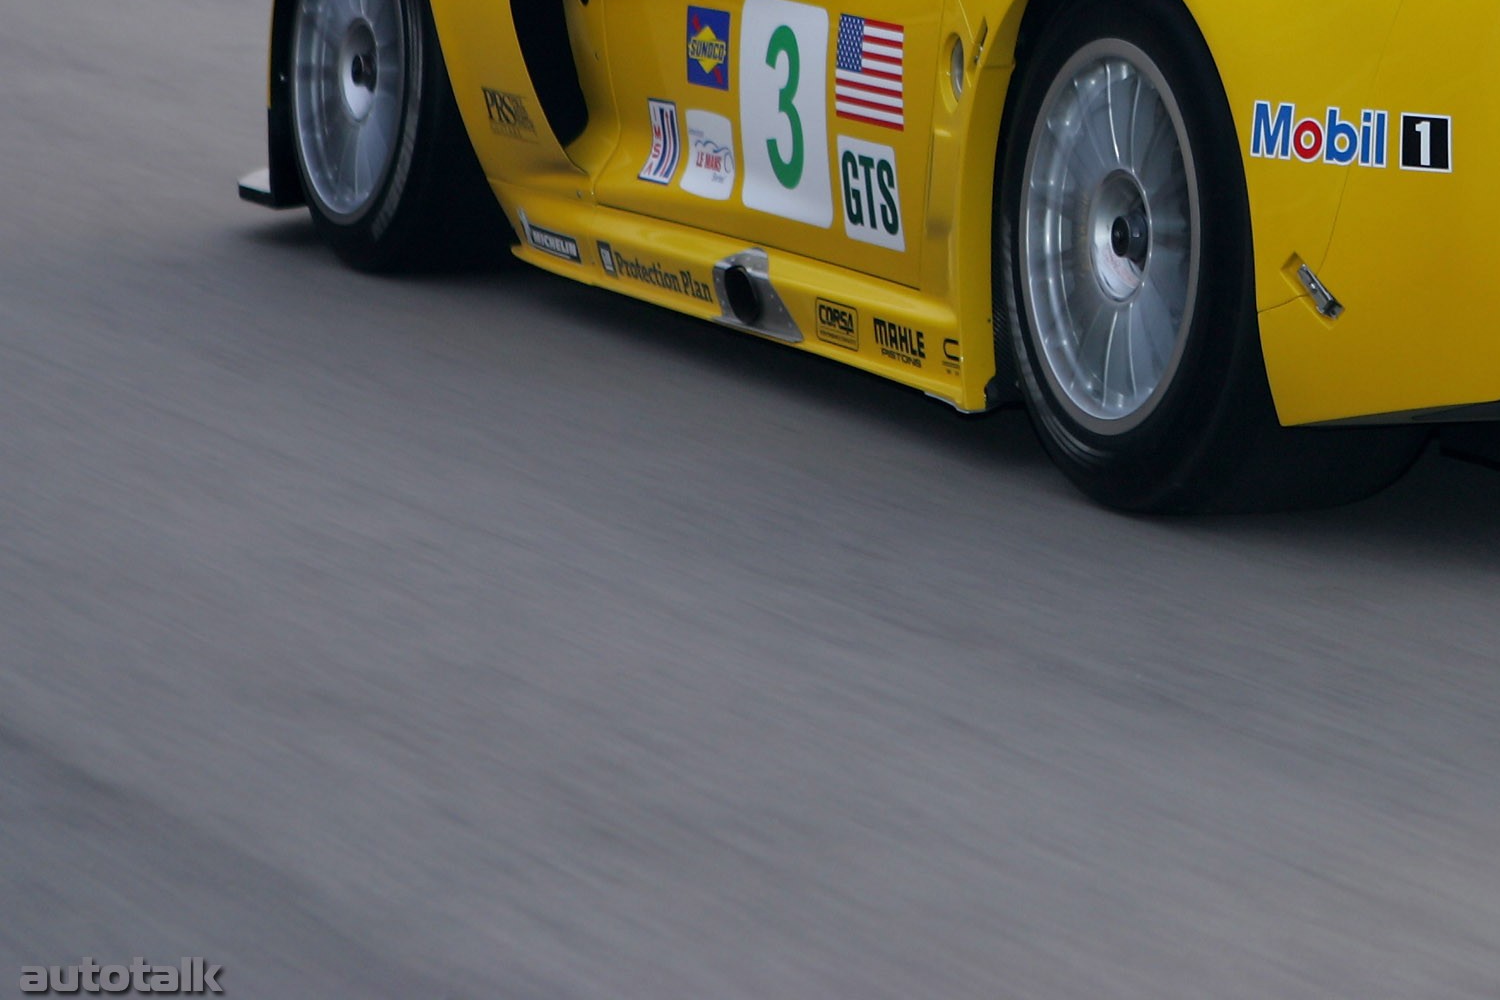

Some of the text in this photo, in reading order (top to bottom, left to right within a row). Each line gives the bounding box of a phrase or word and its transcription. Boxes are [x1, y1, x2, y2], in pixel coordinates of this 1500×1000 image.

[689, 39, 725, 61] SUNOCO
[765, 24, 804, 190] 3
[1250, 100, 1388, 168] Mobil
[841, 151, 899, 235] GTS
[532, 230, 578, 257] MICHELIN
[615, 252, 680, 292] Protection
[680, 270, 713, 303] Plan
[819, 305, 854, 334] CORSA
[873, 317, 926, 359] MAHLE
[881, 348, 922, 368] PISTONS
